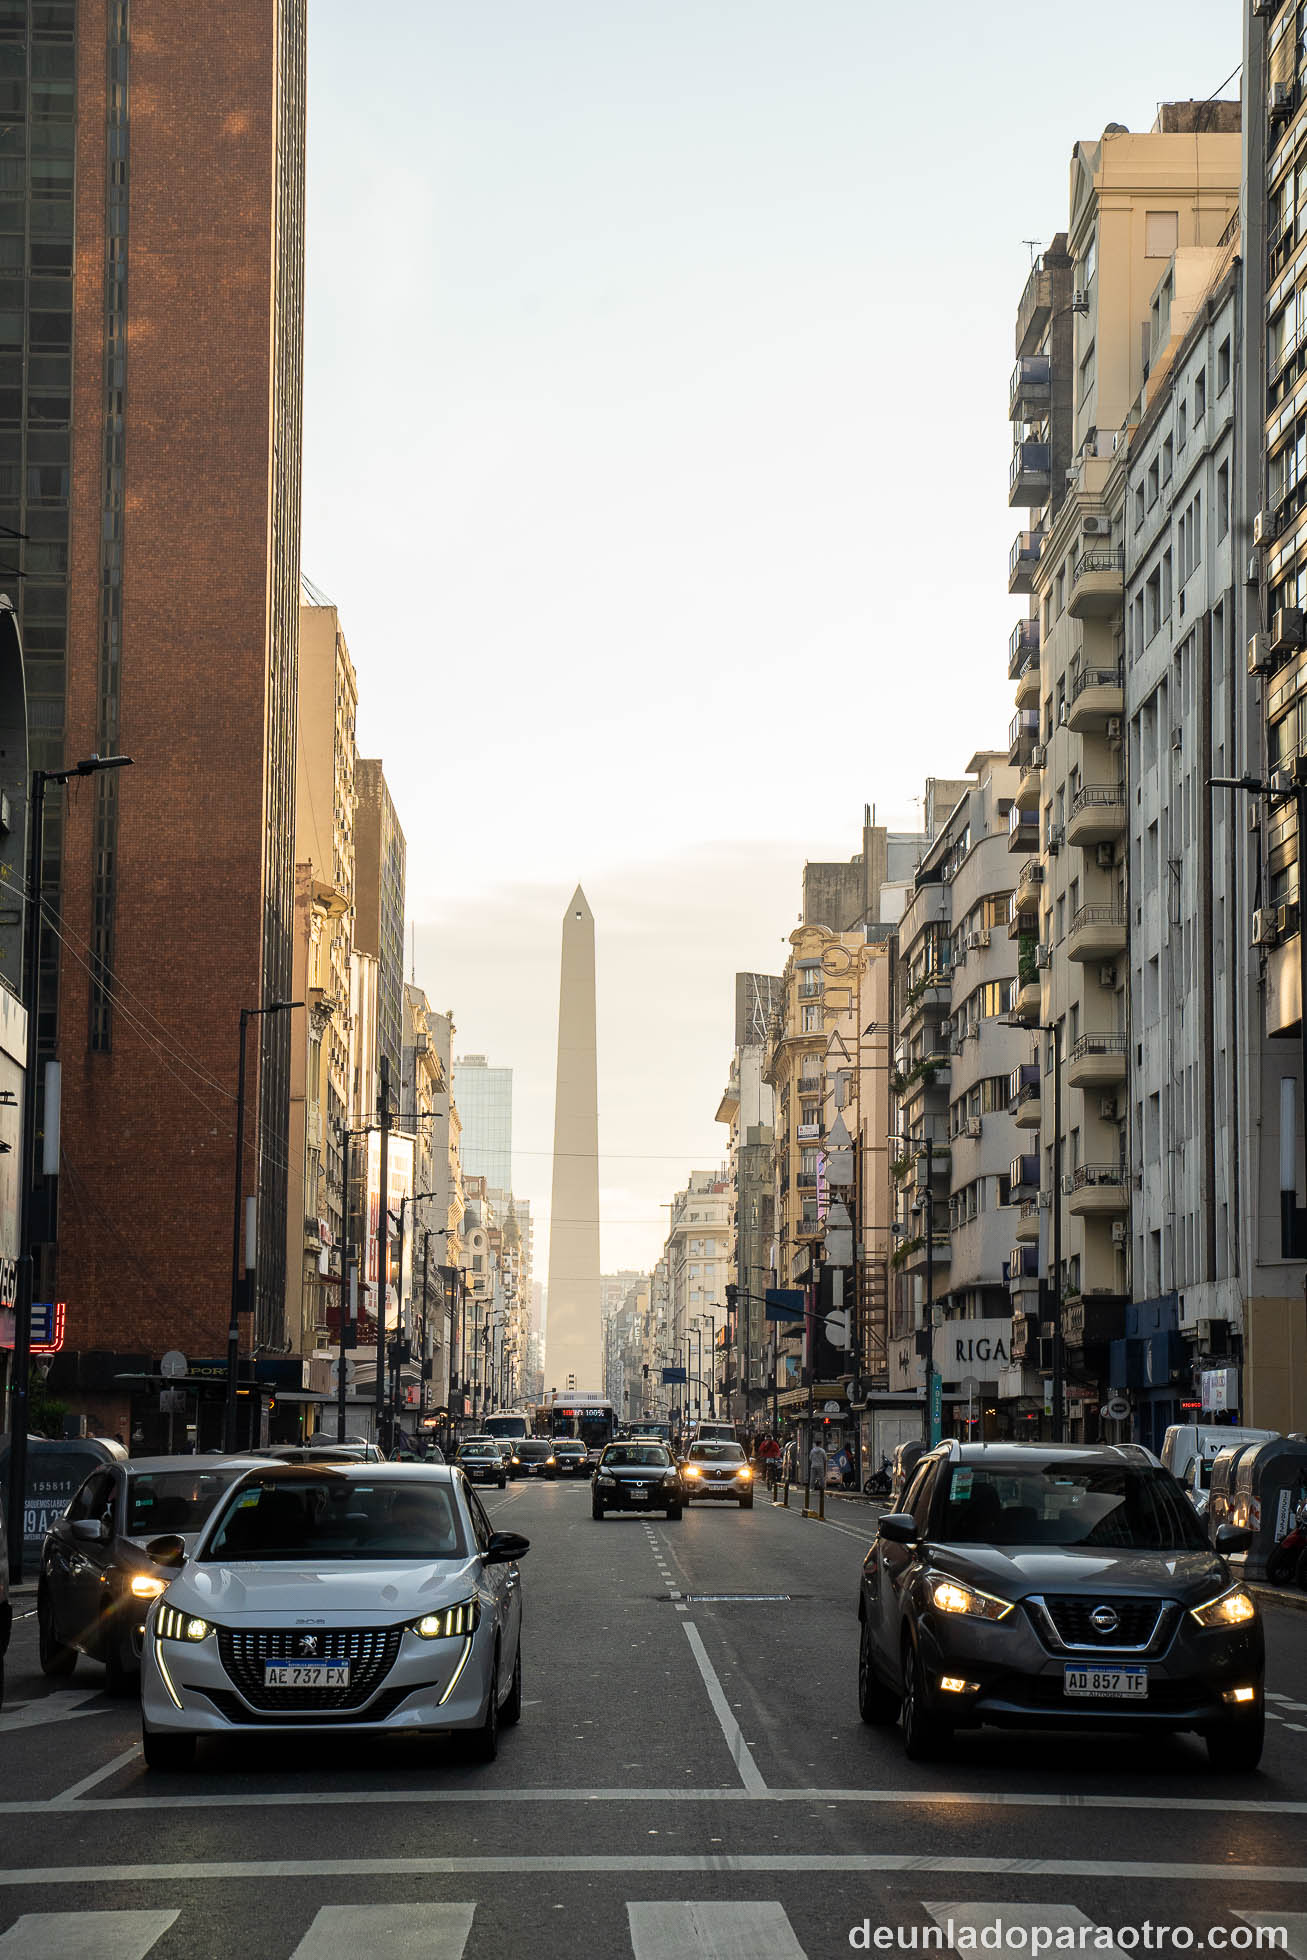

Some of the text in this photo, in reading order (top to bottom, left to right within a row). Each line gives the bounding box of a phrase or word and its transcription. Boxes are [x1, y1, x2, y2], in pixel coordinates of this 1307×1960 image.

[268, 1668, 345, 1684] AE 737 FX
[1069, 1673, 1143, 1690] AD 857 TF
